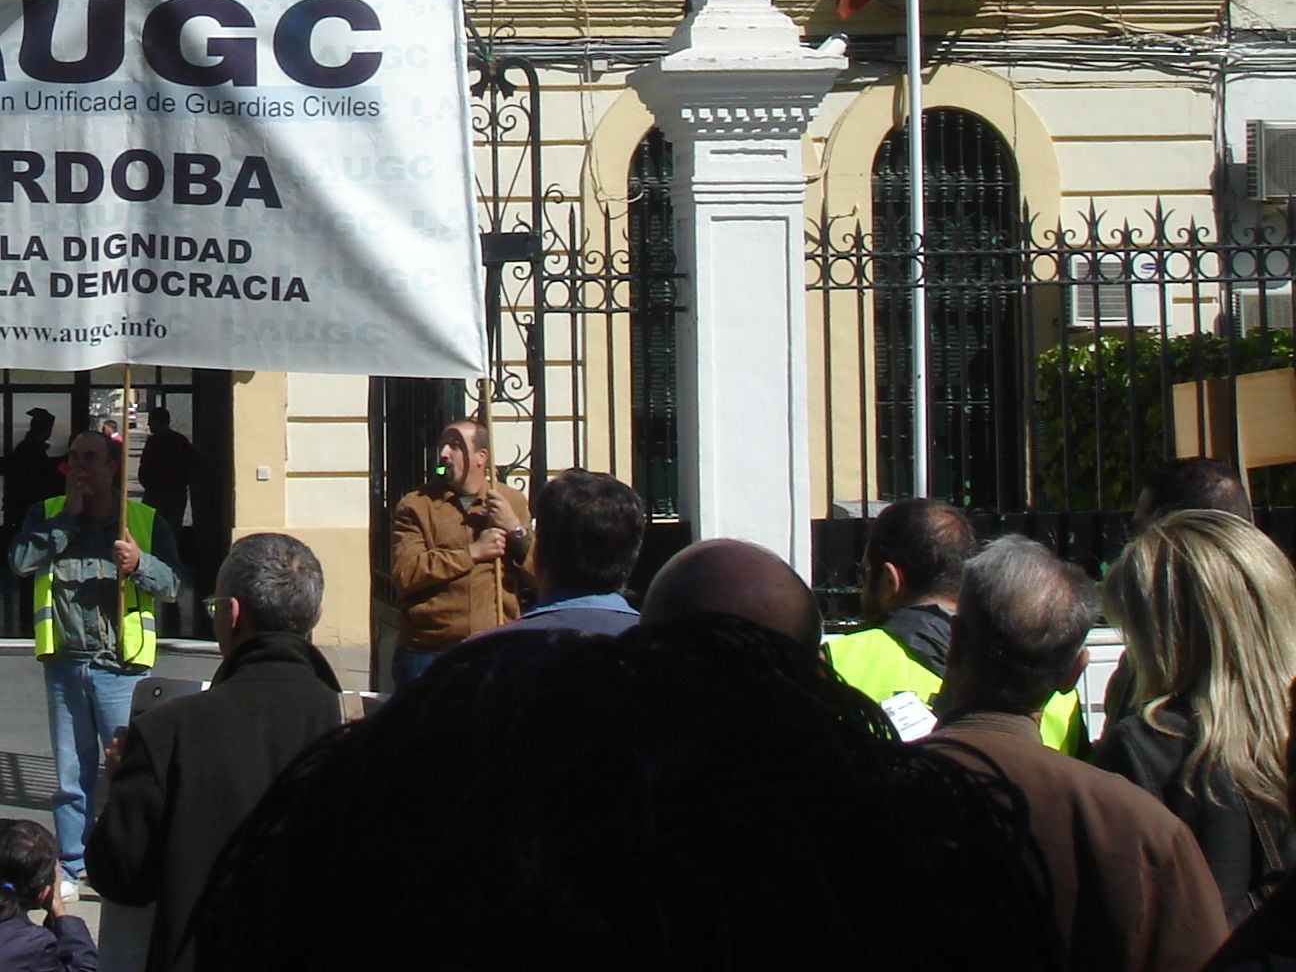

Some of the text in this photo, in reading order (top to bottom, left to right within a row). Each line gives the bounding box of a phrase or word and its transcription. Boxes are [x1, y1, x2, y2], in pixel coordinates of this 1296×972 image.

[24, 90, 137, 112] Unificada
[146, 92, 176, 113] de
[185, 93, 295, 117] Guardias
[303, 95, 380, 117] Civiles
[0, 235, 49, 262] LA
[62, 233, 252, 264] DIGNIDAD
[50, 268, 310, 303] DEMOCRACIA
